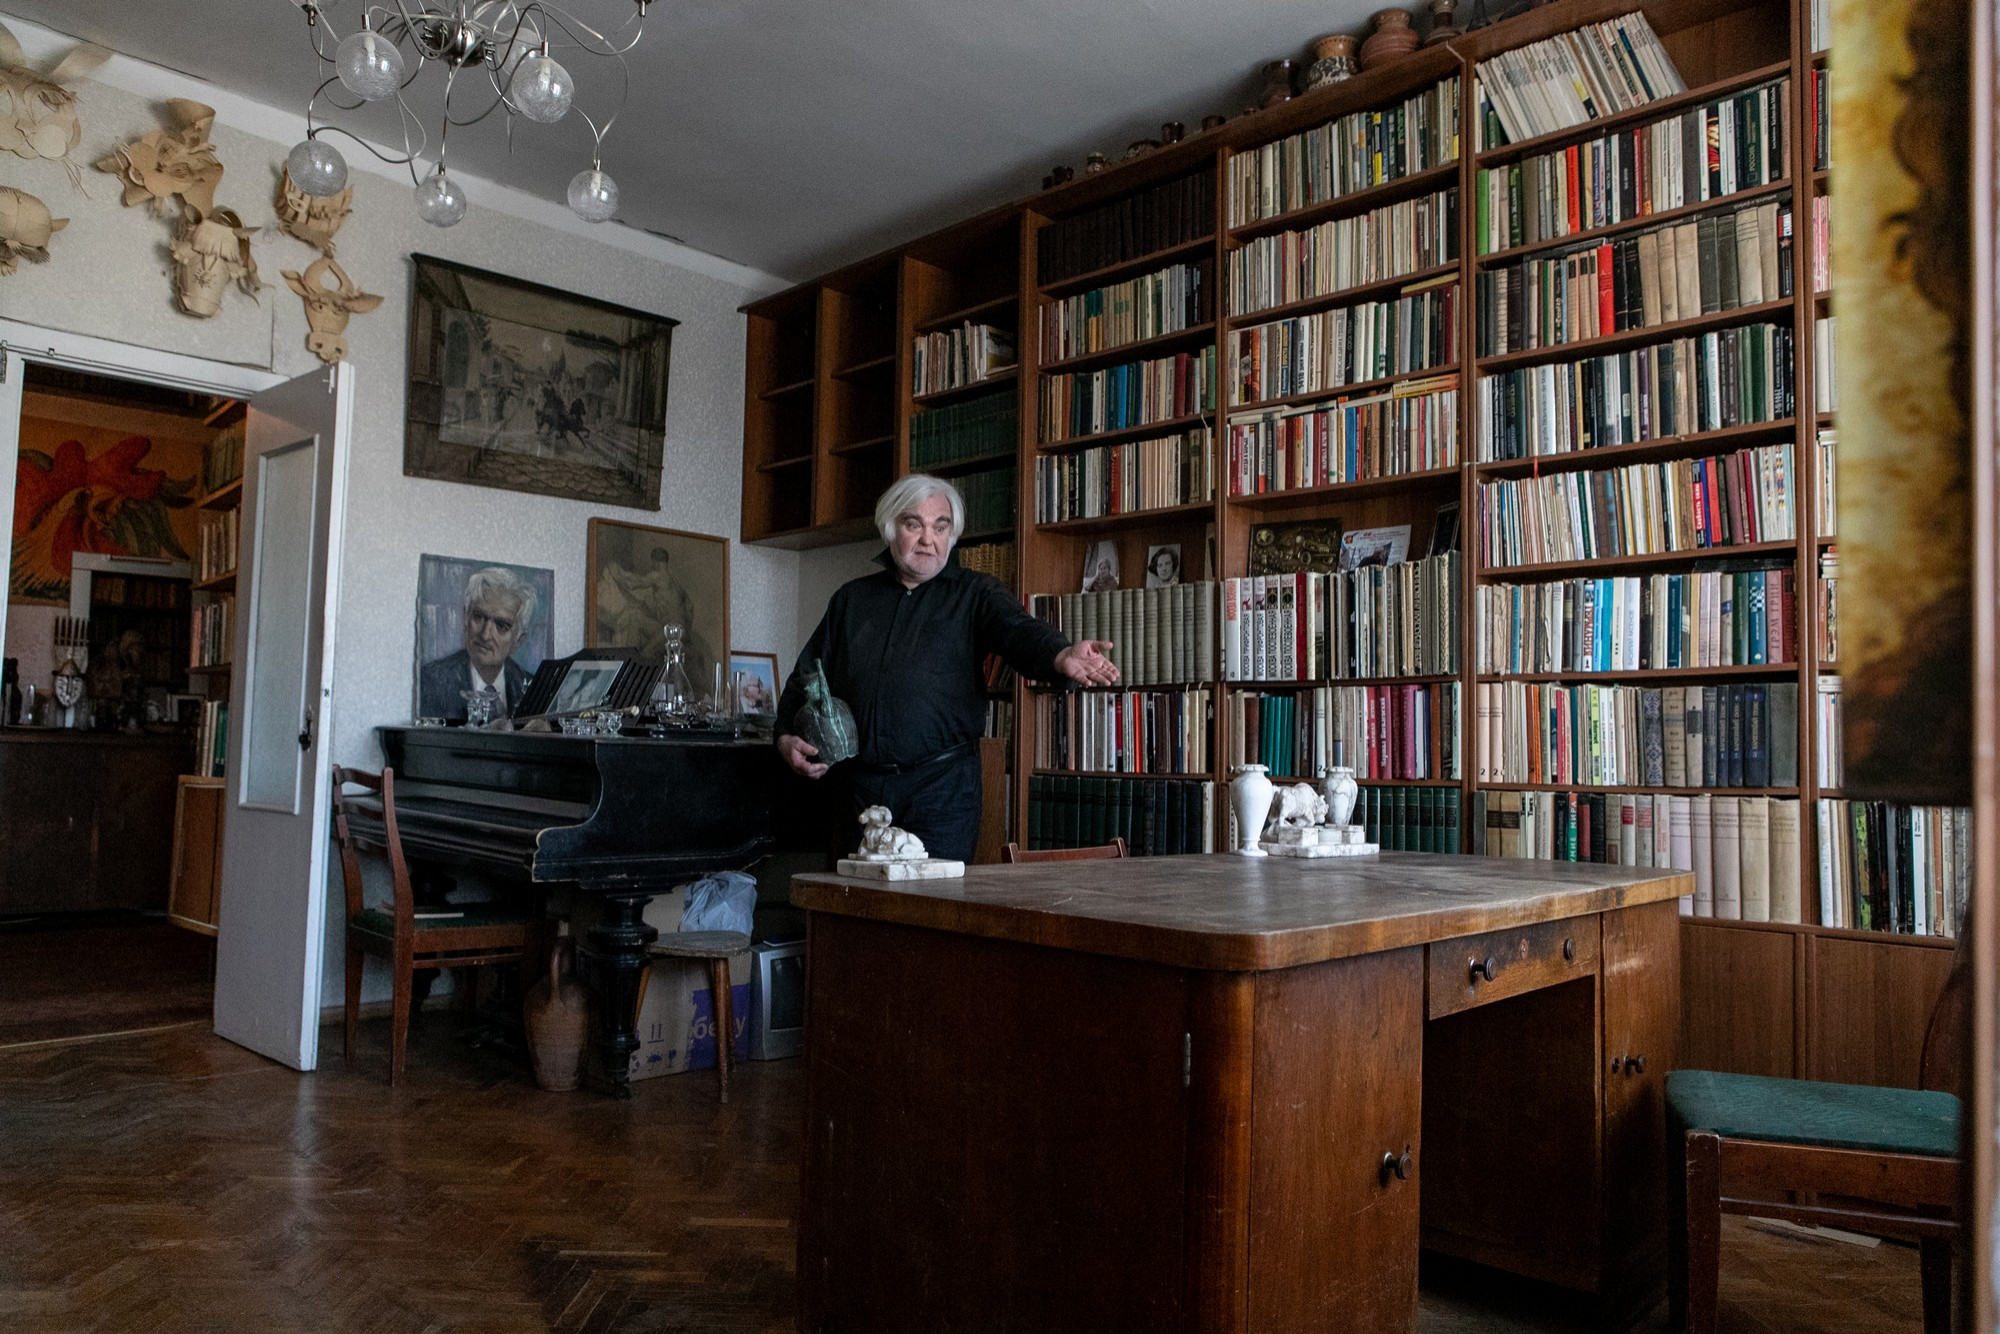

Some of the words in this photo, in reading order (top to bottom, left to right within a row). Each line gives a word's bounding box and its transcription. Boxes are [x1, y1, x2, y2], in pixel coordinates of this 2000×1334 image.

[1268, 610, 1277, 654] ПОСЛЕВОЕННАЯ
[1283, 610, 1292, 654] ПОСЛЕВОЕННАЯ
[1583, 606, 1593, 657] ГЕРМАНИЯ
[1770, 618, 1780, 649] ГРЭМ
[1268, 655, 1277, 678] МОСКВА
[1284, 655, 1292, 678] МОСКВА
[1569, 800, 1577, 829] МИРА
[694, 1014, 747, 1041] беу
